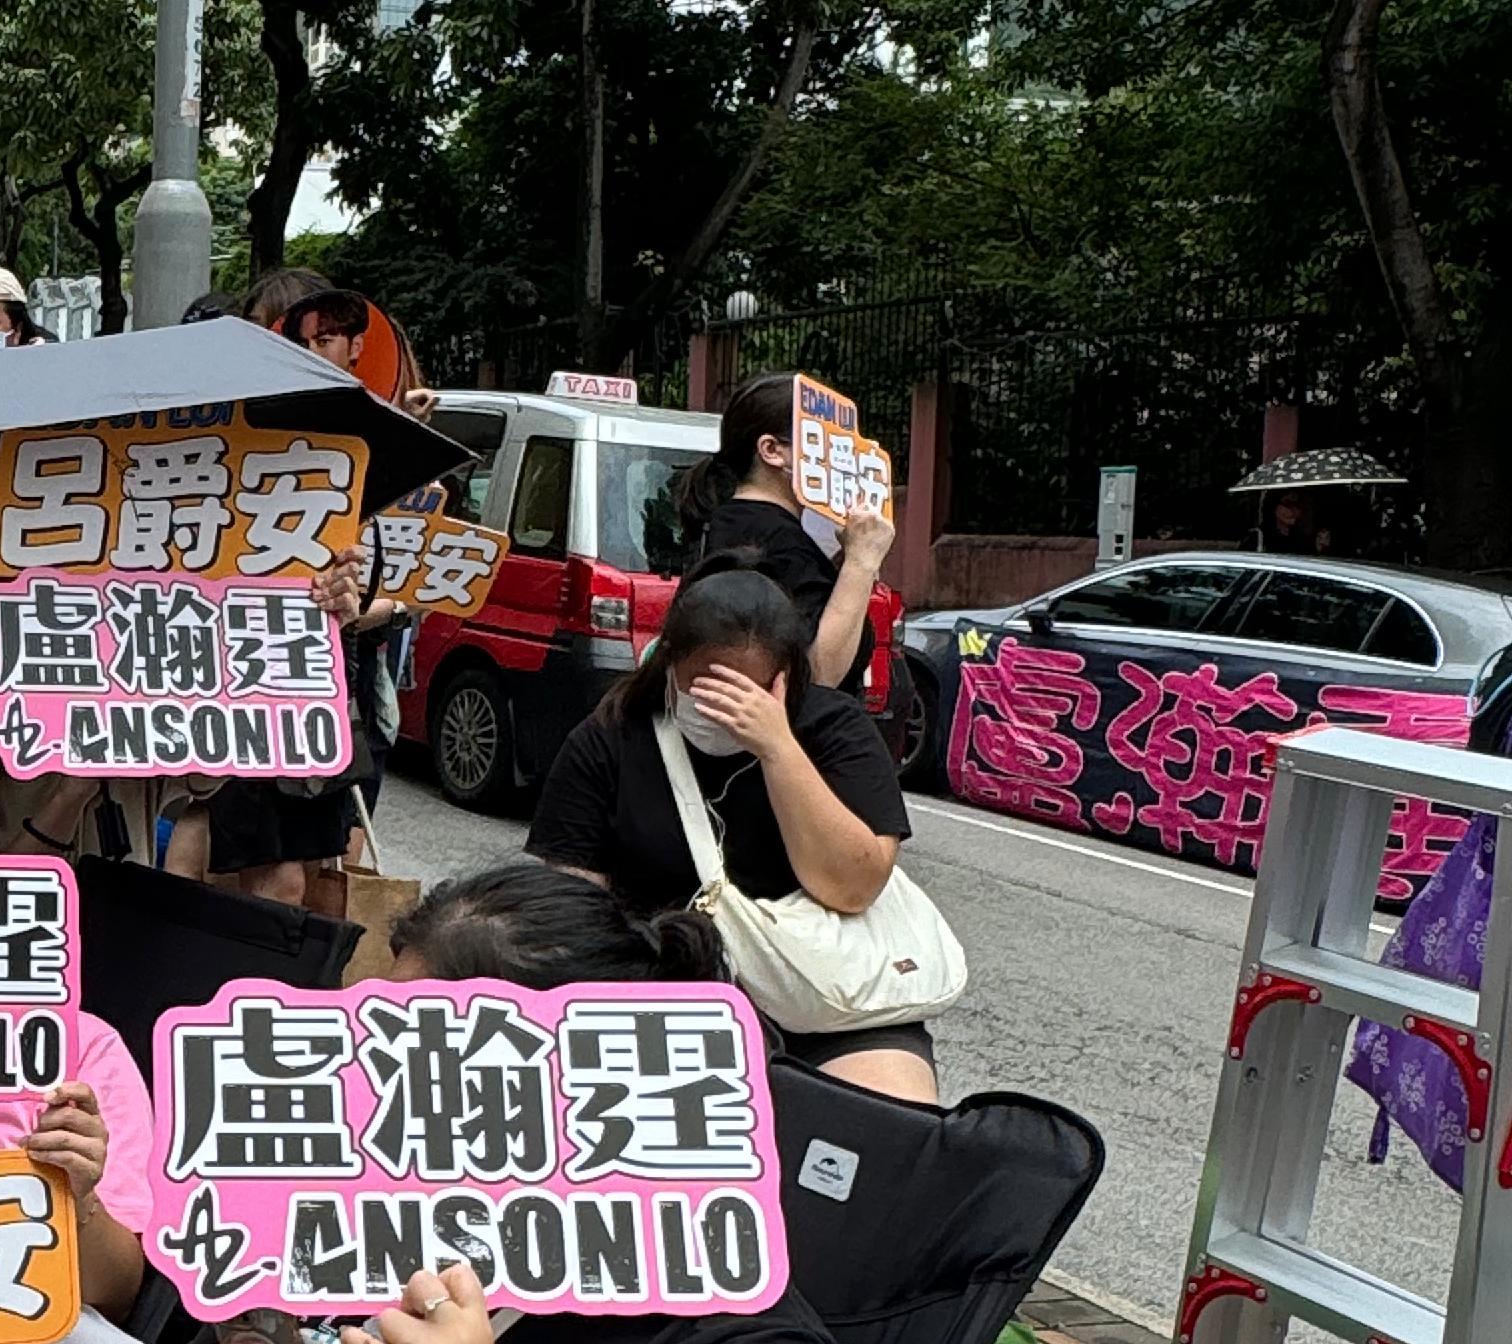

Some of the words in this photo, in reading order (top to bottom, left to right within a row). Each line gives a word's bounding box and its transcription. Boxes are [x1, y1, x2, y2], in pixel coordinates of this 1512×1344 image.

[565, 376, 632, 398] TAXI
[0, 436, 352, 575] 呂爵安
[68, 704, 269, 767] ANSON
[285, 705, 342, 765] LO
[175, 1006, 759, 1178] 盧瀚霆
[289, 1195, 641, 1295] ANSON
[661, 1195, 760, 1295] LO
